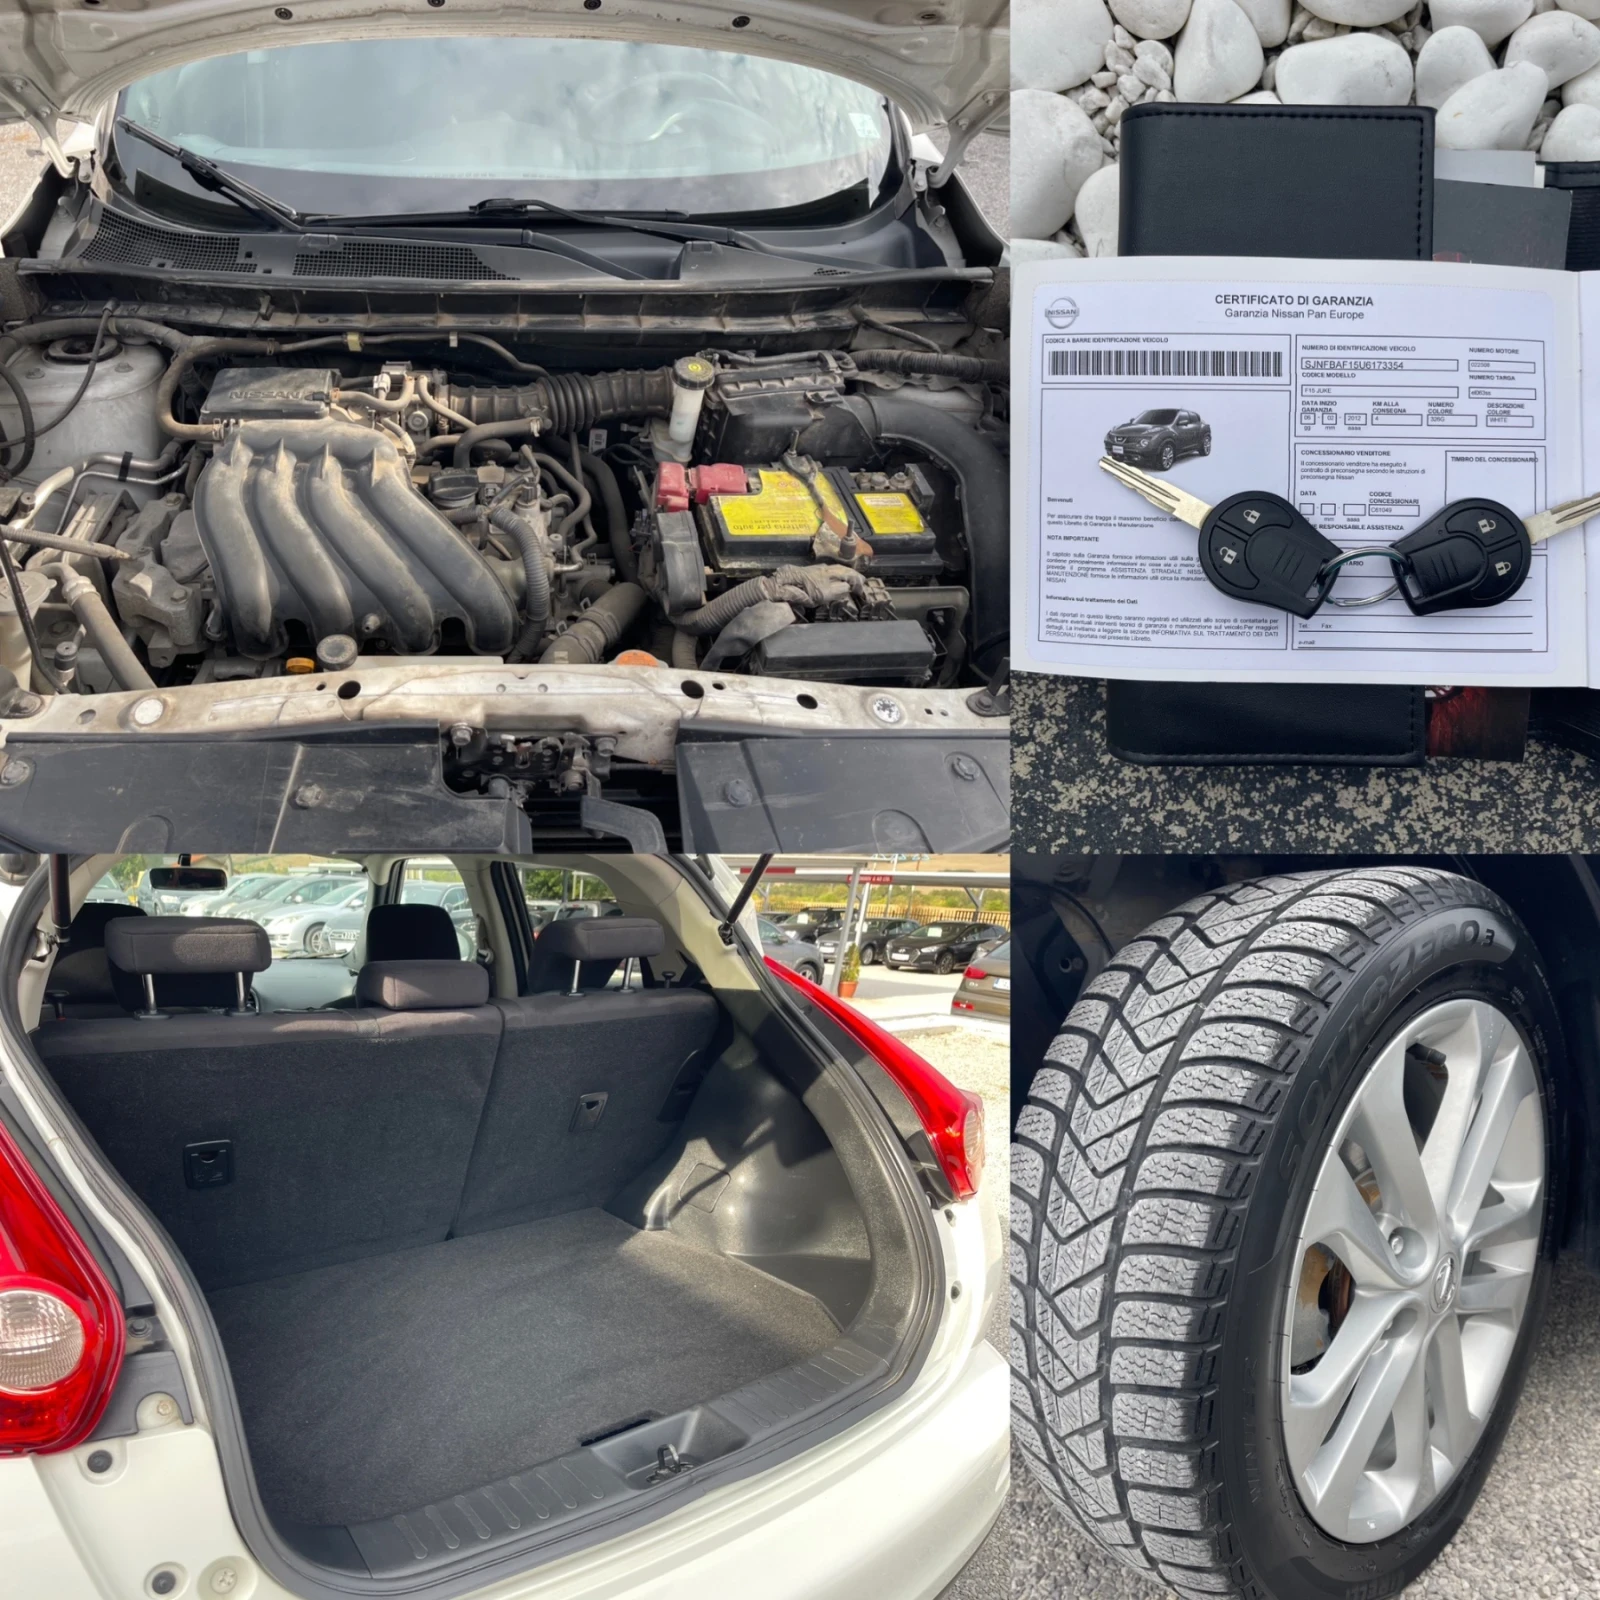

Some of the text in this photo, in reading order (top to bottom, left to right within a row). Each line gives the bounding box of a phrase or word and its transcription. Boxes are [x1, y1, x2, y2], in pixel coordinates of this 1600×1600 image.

[1215, 294, 1374, 306] CERTIFICATO DI GARANZIA
[1225, 308, 1364, 321] Garanzia Nissan Pan Europe
[1304, 360, 1404, 370] SJNFBAF15U6173354
[229, 391, 303, 399] NISSAN
